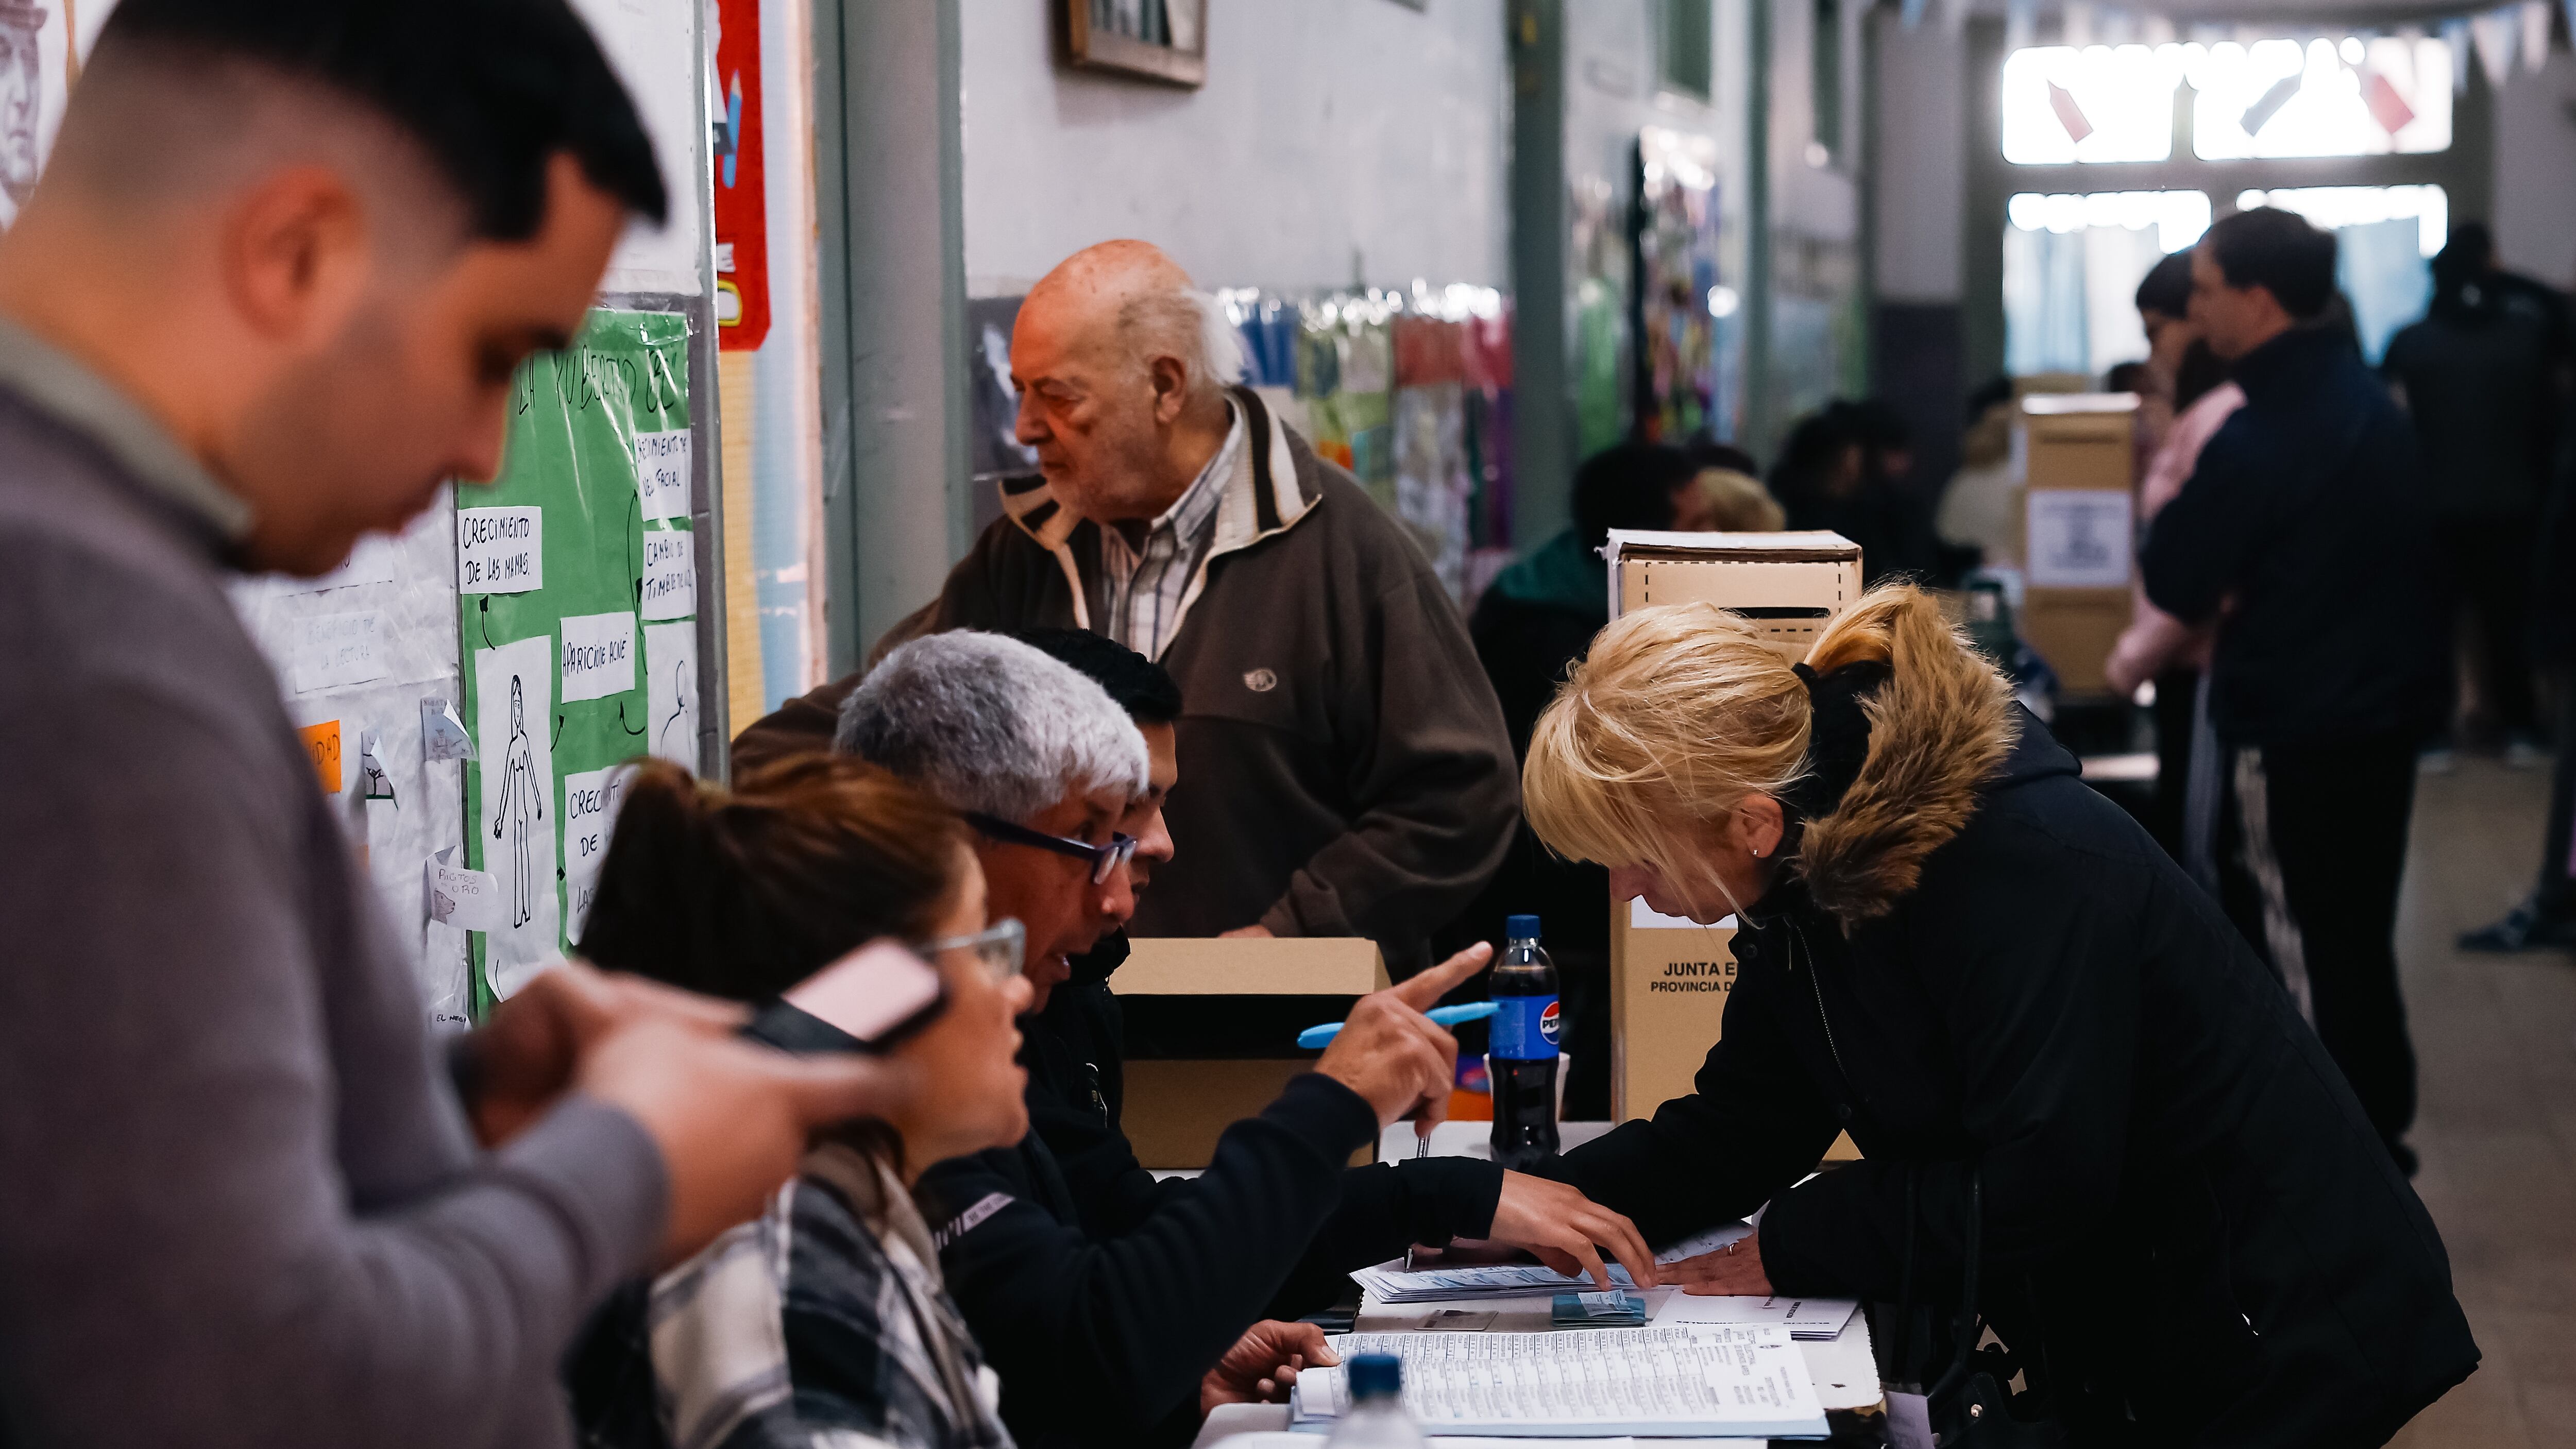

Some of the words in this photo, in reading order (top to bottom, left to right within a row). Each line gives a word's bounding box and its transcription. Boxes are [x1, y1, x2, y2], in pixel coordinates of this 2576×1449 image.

[518, 355, 535, 415] LA
[465, 560, 481, 585] DE
[488, 557, 500, 581] LAS
[581, 834, 598, 857] DE
[452, 885, 479, 895] ORO
[1664, 962, 1720, 977] JUNTA
[1725, 962, 1735, 976] E
[1651, 981, 1721, 993] PROVINCIA
[1724, 982, 1733, 992] D
[436, 1014, 446, 1022] EL
